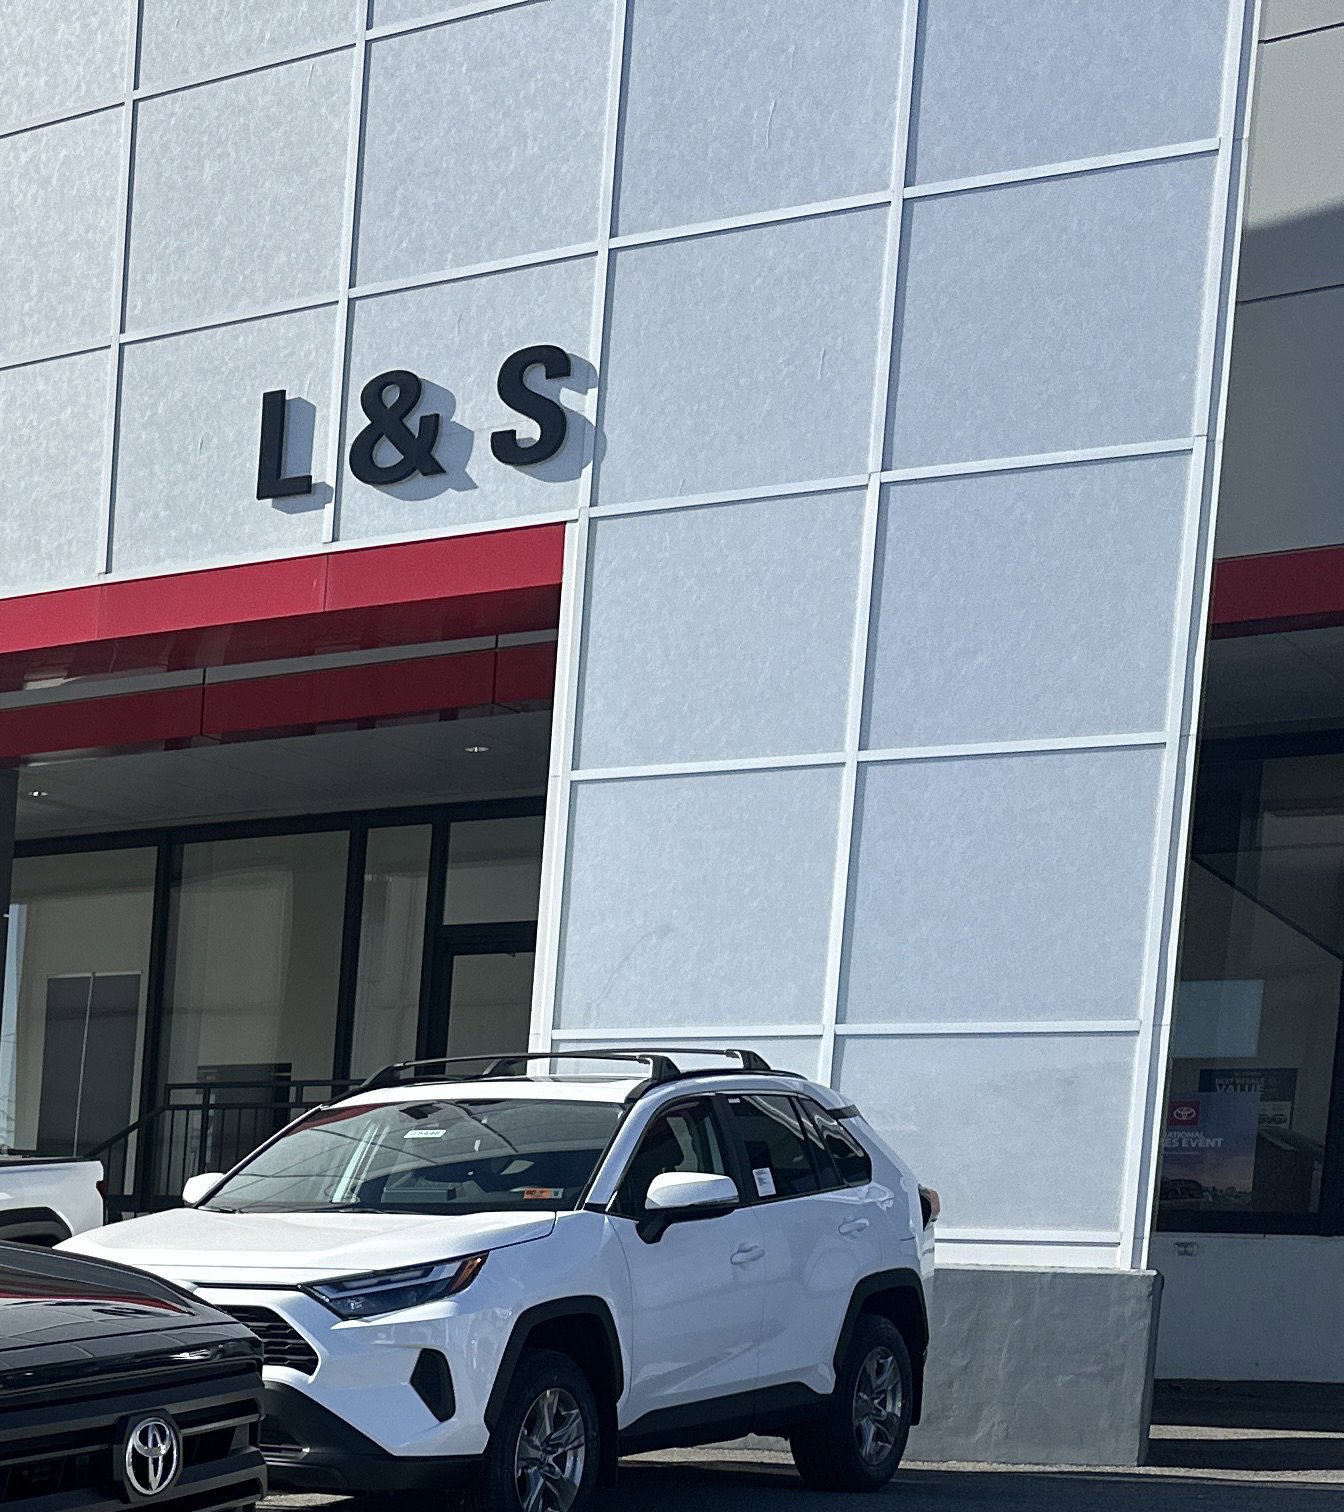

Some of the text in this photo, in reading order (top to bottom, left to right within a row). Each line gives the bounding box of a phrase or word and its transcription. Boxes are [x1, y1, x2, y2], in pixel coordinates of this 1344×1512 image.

[256, 344, 571, 501] L & S
[1182, 1137, 1224, 1148] EVENT
